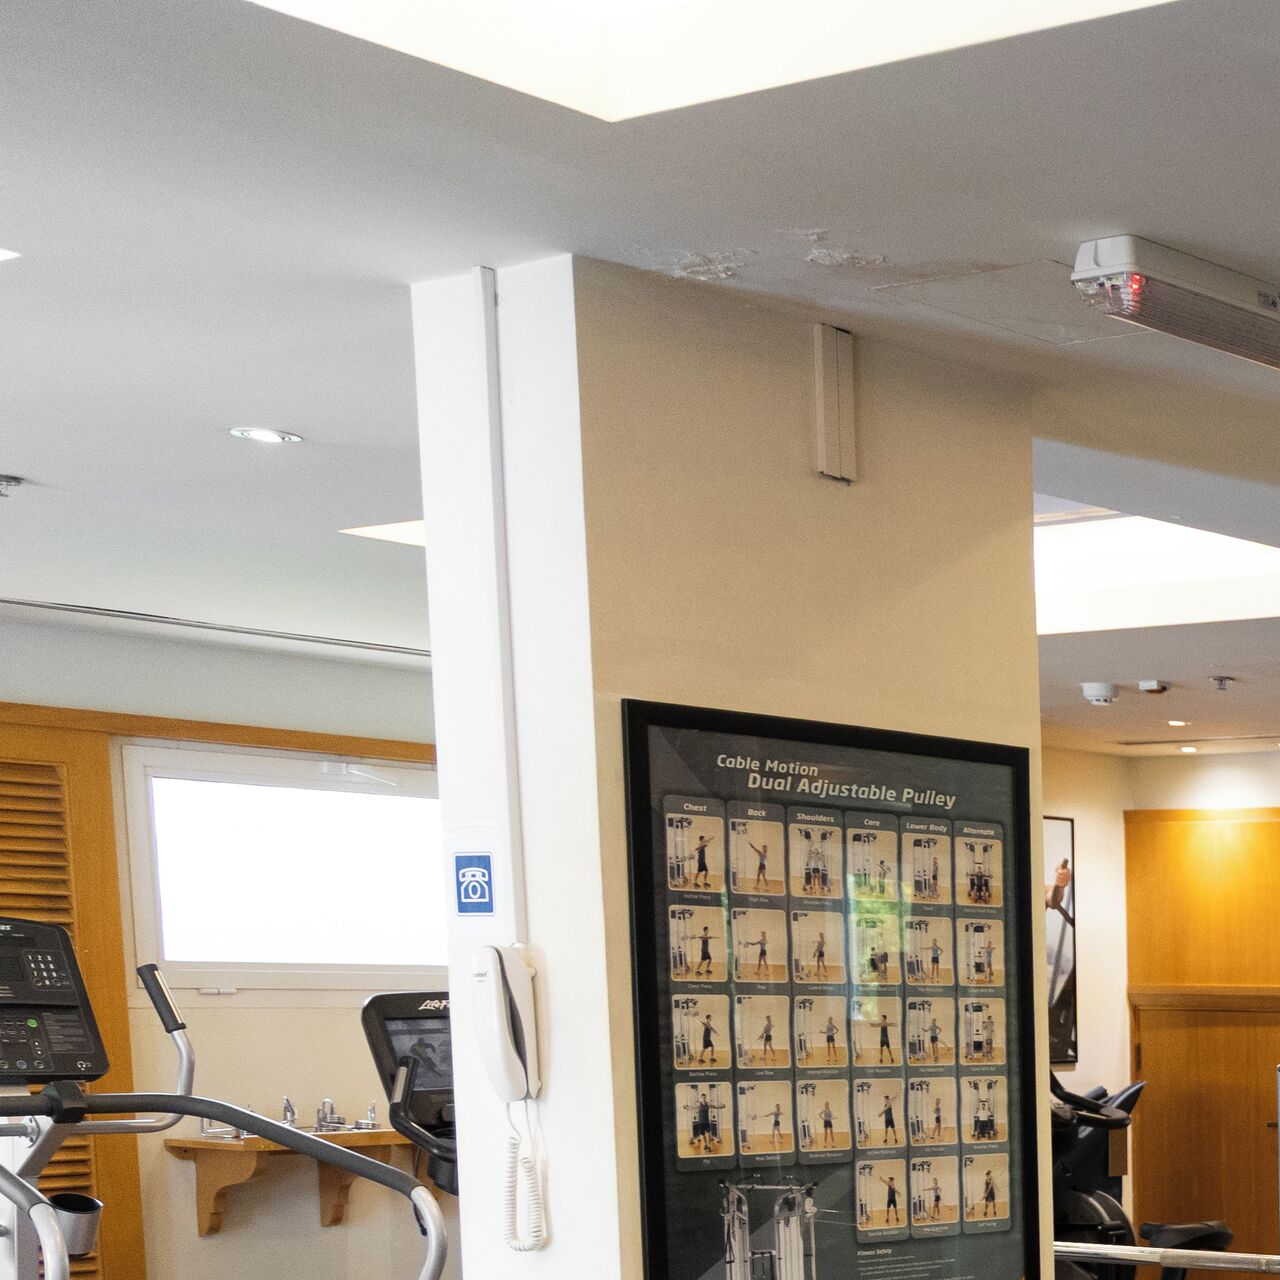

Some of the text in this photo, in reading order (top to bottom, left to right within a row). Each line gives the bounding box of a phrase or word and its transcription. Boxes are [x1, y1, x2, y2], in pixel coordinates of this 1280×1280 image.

[716, 754, 819, 777] Cable Motion
[747, 773, 957, 810] Dual Adjustable Pulley
[683, 802, 707, 812] Chest
[747, 808, 767, 817] Back
[796, 812, 835, 823] Shoulders
[863, 818, 881, 827] Core
[906, 821, 948, 834] Lower Body
[963, 827, 995, 837] Alternate
